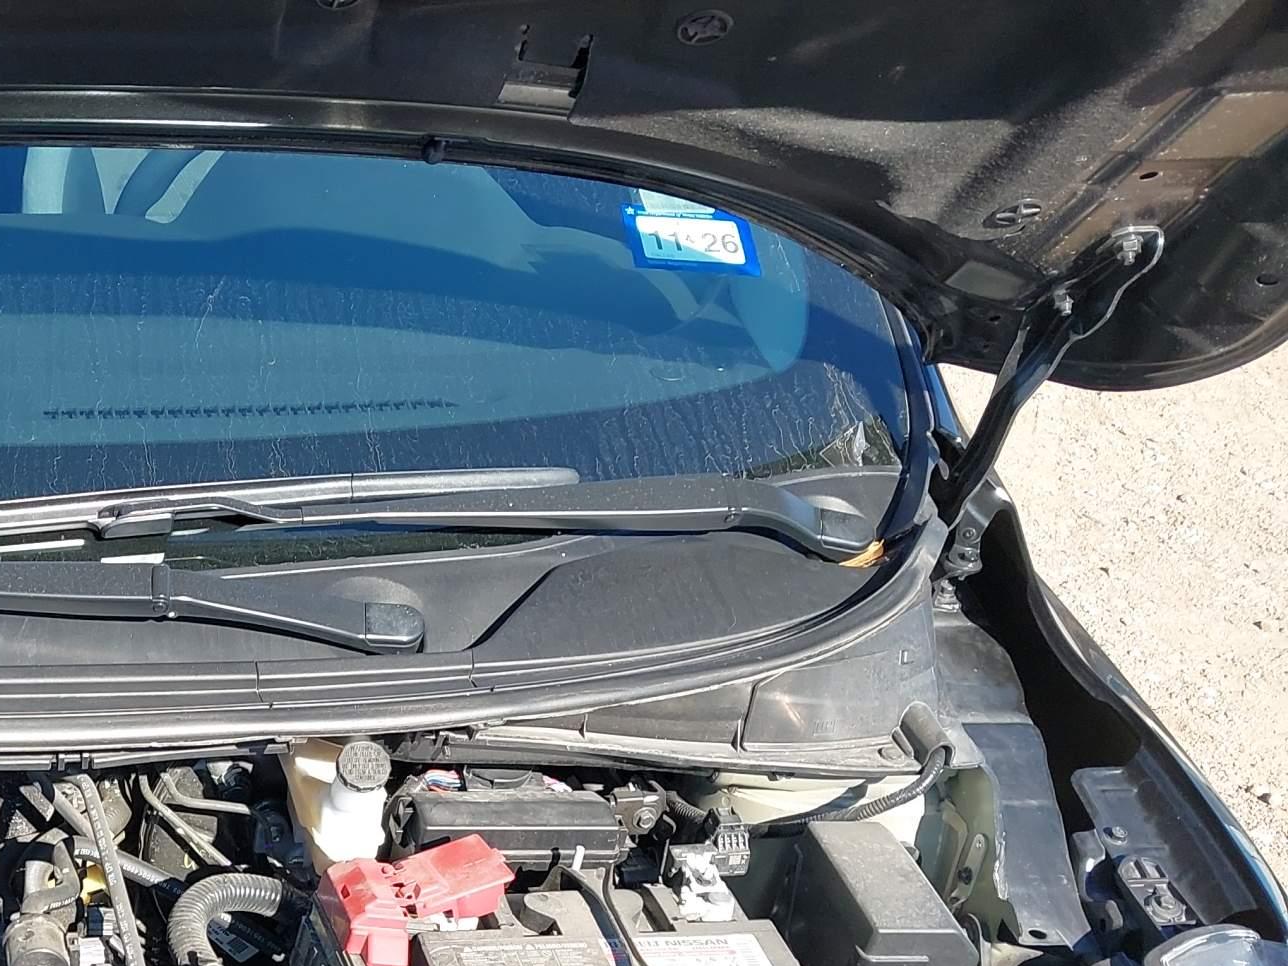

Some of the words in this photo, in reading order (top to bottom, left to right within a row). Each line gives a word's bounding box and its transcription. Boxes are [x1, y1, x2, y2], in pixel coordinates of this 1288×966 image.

[647, 230, 683, 251] 11
[702, 232, 740, 254] 26
[665, 938, 729, 947] NISSAN
